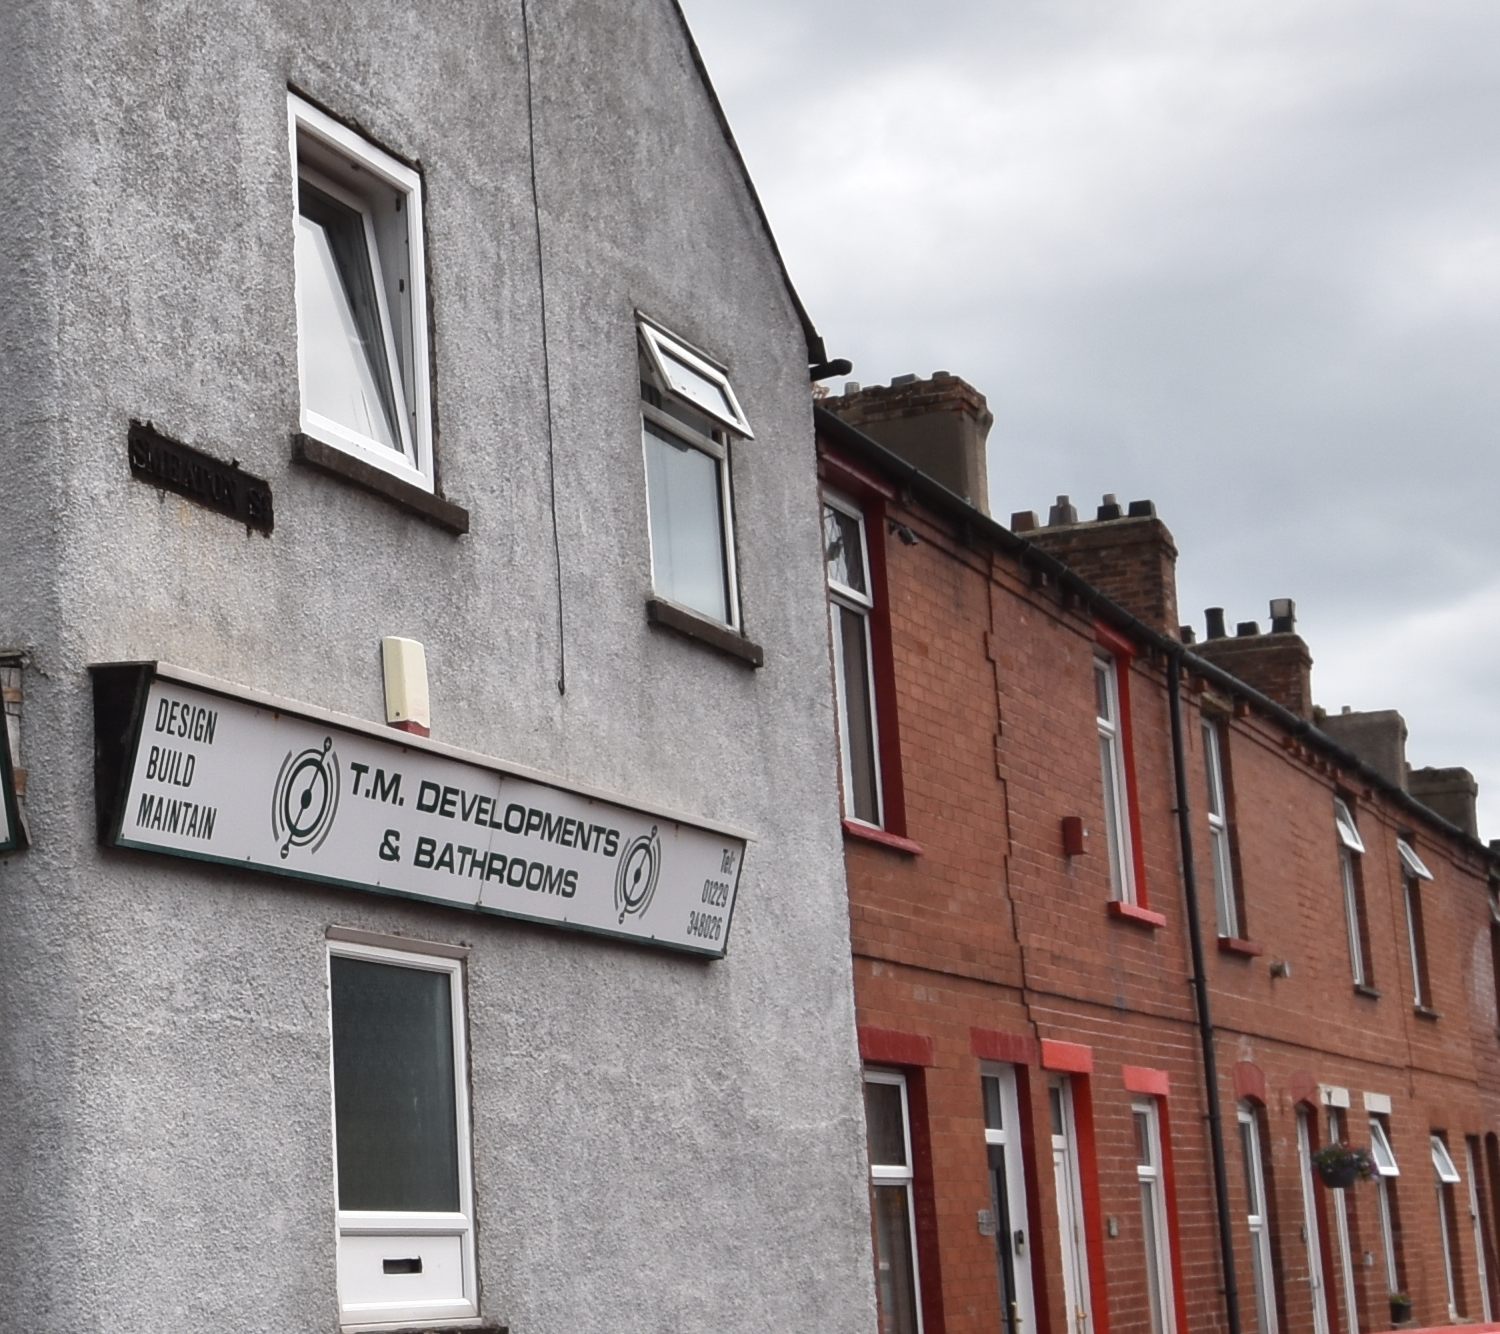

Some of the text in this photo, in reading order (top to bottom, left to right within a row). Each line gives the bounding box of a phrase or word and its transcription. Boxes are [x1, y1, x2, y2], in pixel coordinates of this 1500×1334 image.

[155, 698, 218, 745] DESIGN
[146, 745, 196, 788] BUILD
[136, 793, 217, 840] MAINTAIN
[350, 762, 620, 857] T.M. DEVELOPMENTS
[379, 829, 579, 898] & BATHROOMS
[720, 848, 736, 875] Tel:
[702, 879, 729, 908] 01229
[687, 910, 722, 941] 348026
